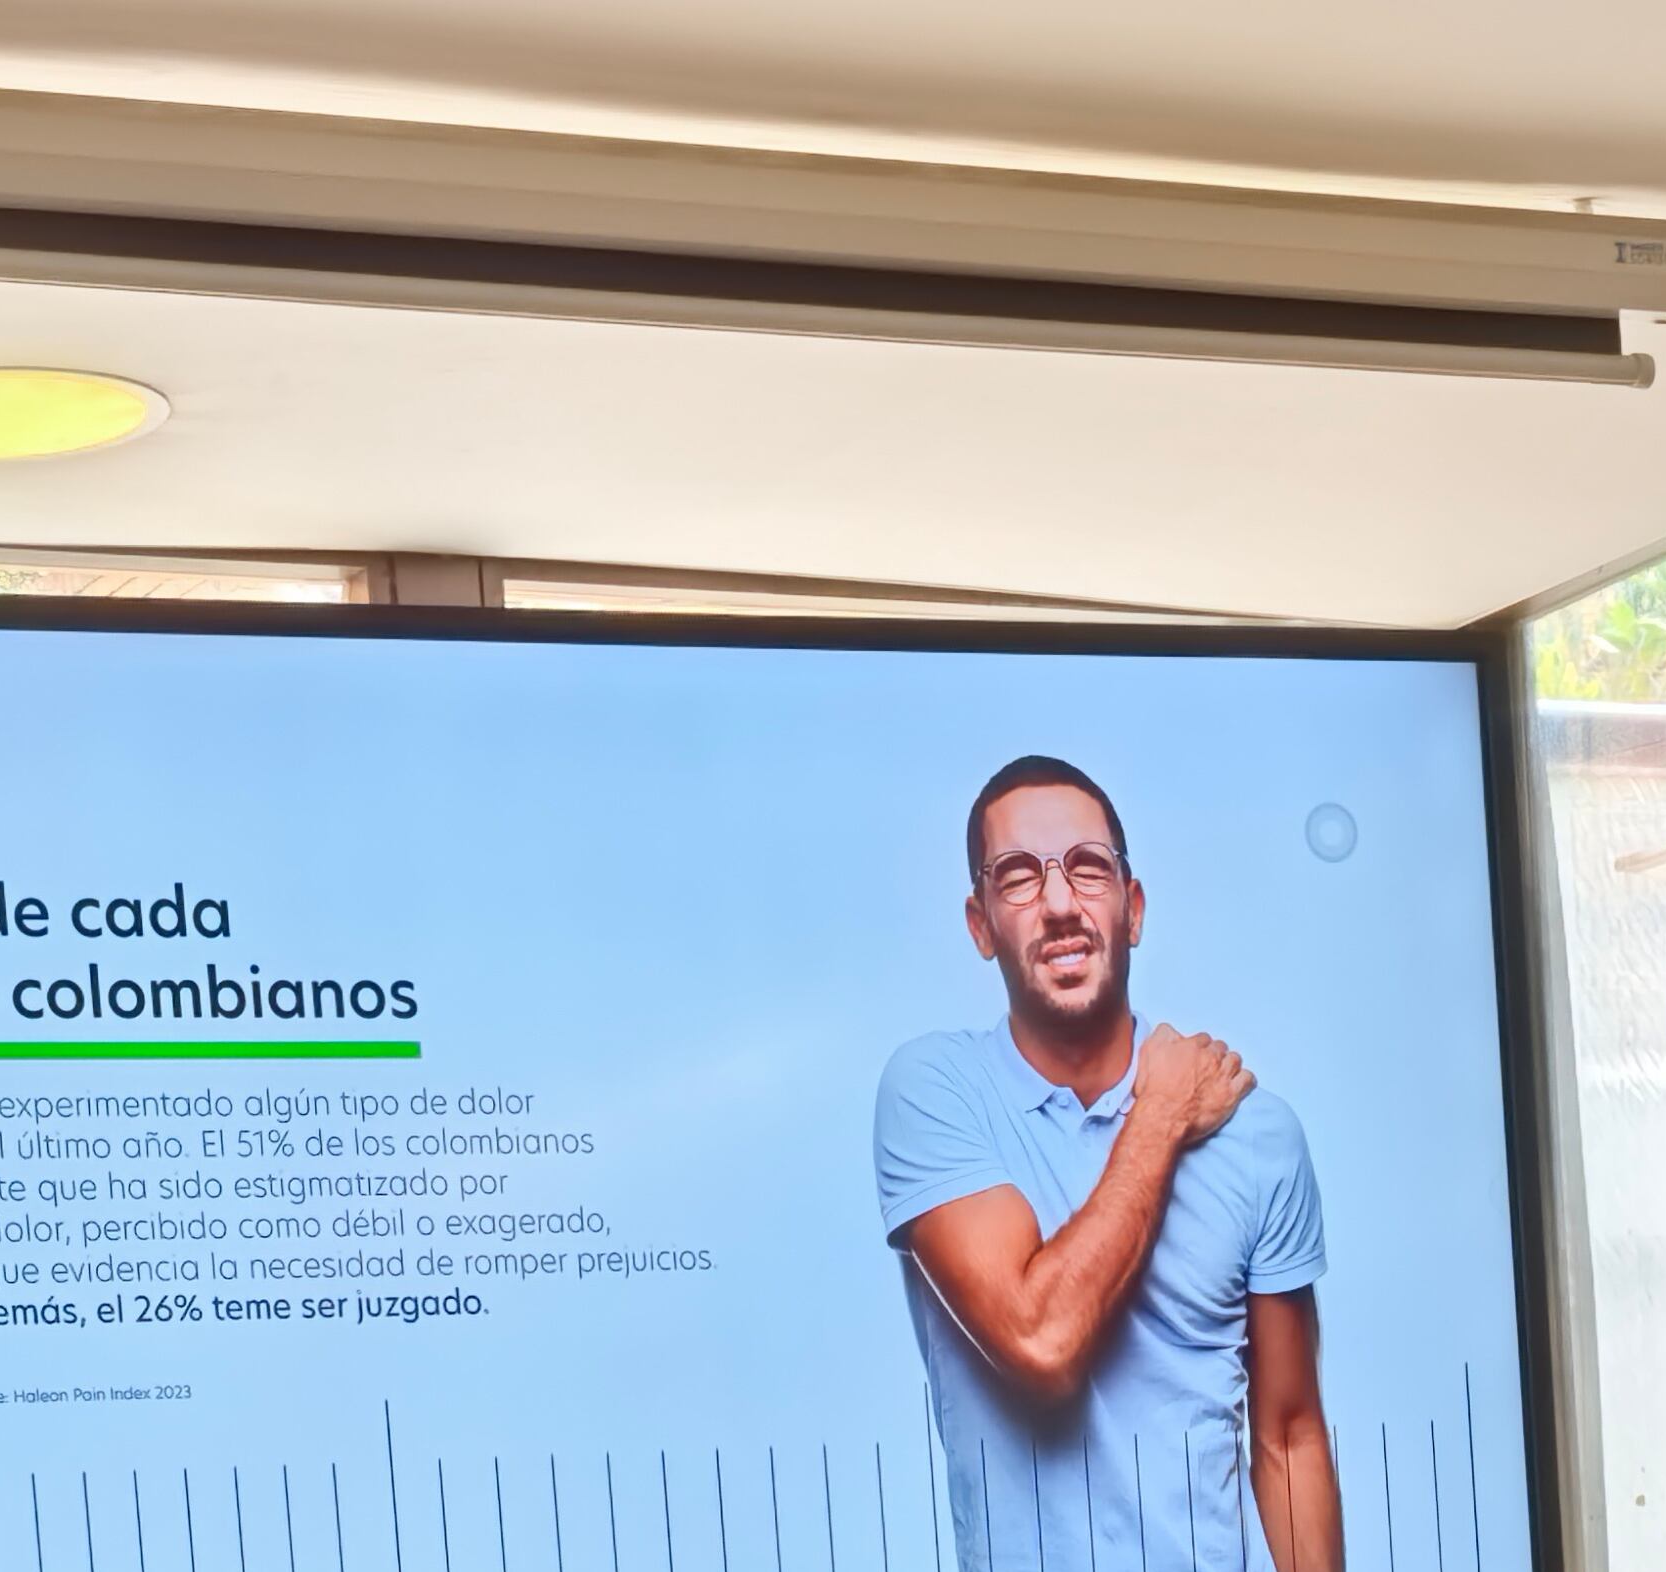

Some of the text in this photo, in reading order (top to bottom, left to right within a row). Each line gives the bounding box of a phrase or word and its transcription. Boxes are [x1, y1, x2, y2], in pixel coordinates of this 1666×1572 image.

[70, 881, 231, 939] cada
[11, 962, 418, 1020] colombianos
[244, 1086, 331, 1124] algún
[339, 1091, 400, 1124] tipo
[409, 1086, 448, 1116] de
[457, 1085, 535, 1116] dolor
[17, 1129, 112, 1161] último
[201, 1128, 225, 1158] El
[236, 1128, 295, 1159] 51%
[304, 1127, 344, 1158] de
[354, 1127, 396, 1157] los
[405, 1125, 595, 1156] colombianos
[37, 1178, 98, 1209] que
[107, 1170, 148, 1201] ha
[158, 1169, 223, 1201] sido
[233, 1166, 449, 1206] estigmatizado
[459, 1174, 509, 1203] por
[81, 1210, 228, 1249] percibido
[238, 1216, 322, 1240] como
[331, 1207, 405, 1239] débil
[416, 1215, 436, 1237] o
[445, 1204, 611, 1243] exagerado,
[50, 1252, 200, 1284] evidencia
[210, 1251, 239, 1281] la
[249, 1247, 405, 1280] necesidad
[416, 1247, 454, 1277] de
[464, 1252, 568, 1281] romper
[96, 1293, 124, 1324] el
[133, 1293, 204, 1323] 26%
[211, 1295, 292, 1322] teme
[301, 1297, 349, 1320] ser
[356, 1286, 490, 1326] juzgado.
[13, 1387, 69, 1404] Haleon
[72, 1387, 107, 1402] Pain
[109, 1386, 152, 1401] Index
[154, 1384, 192, 1400] 2023
